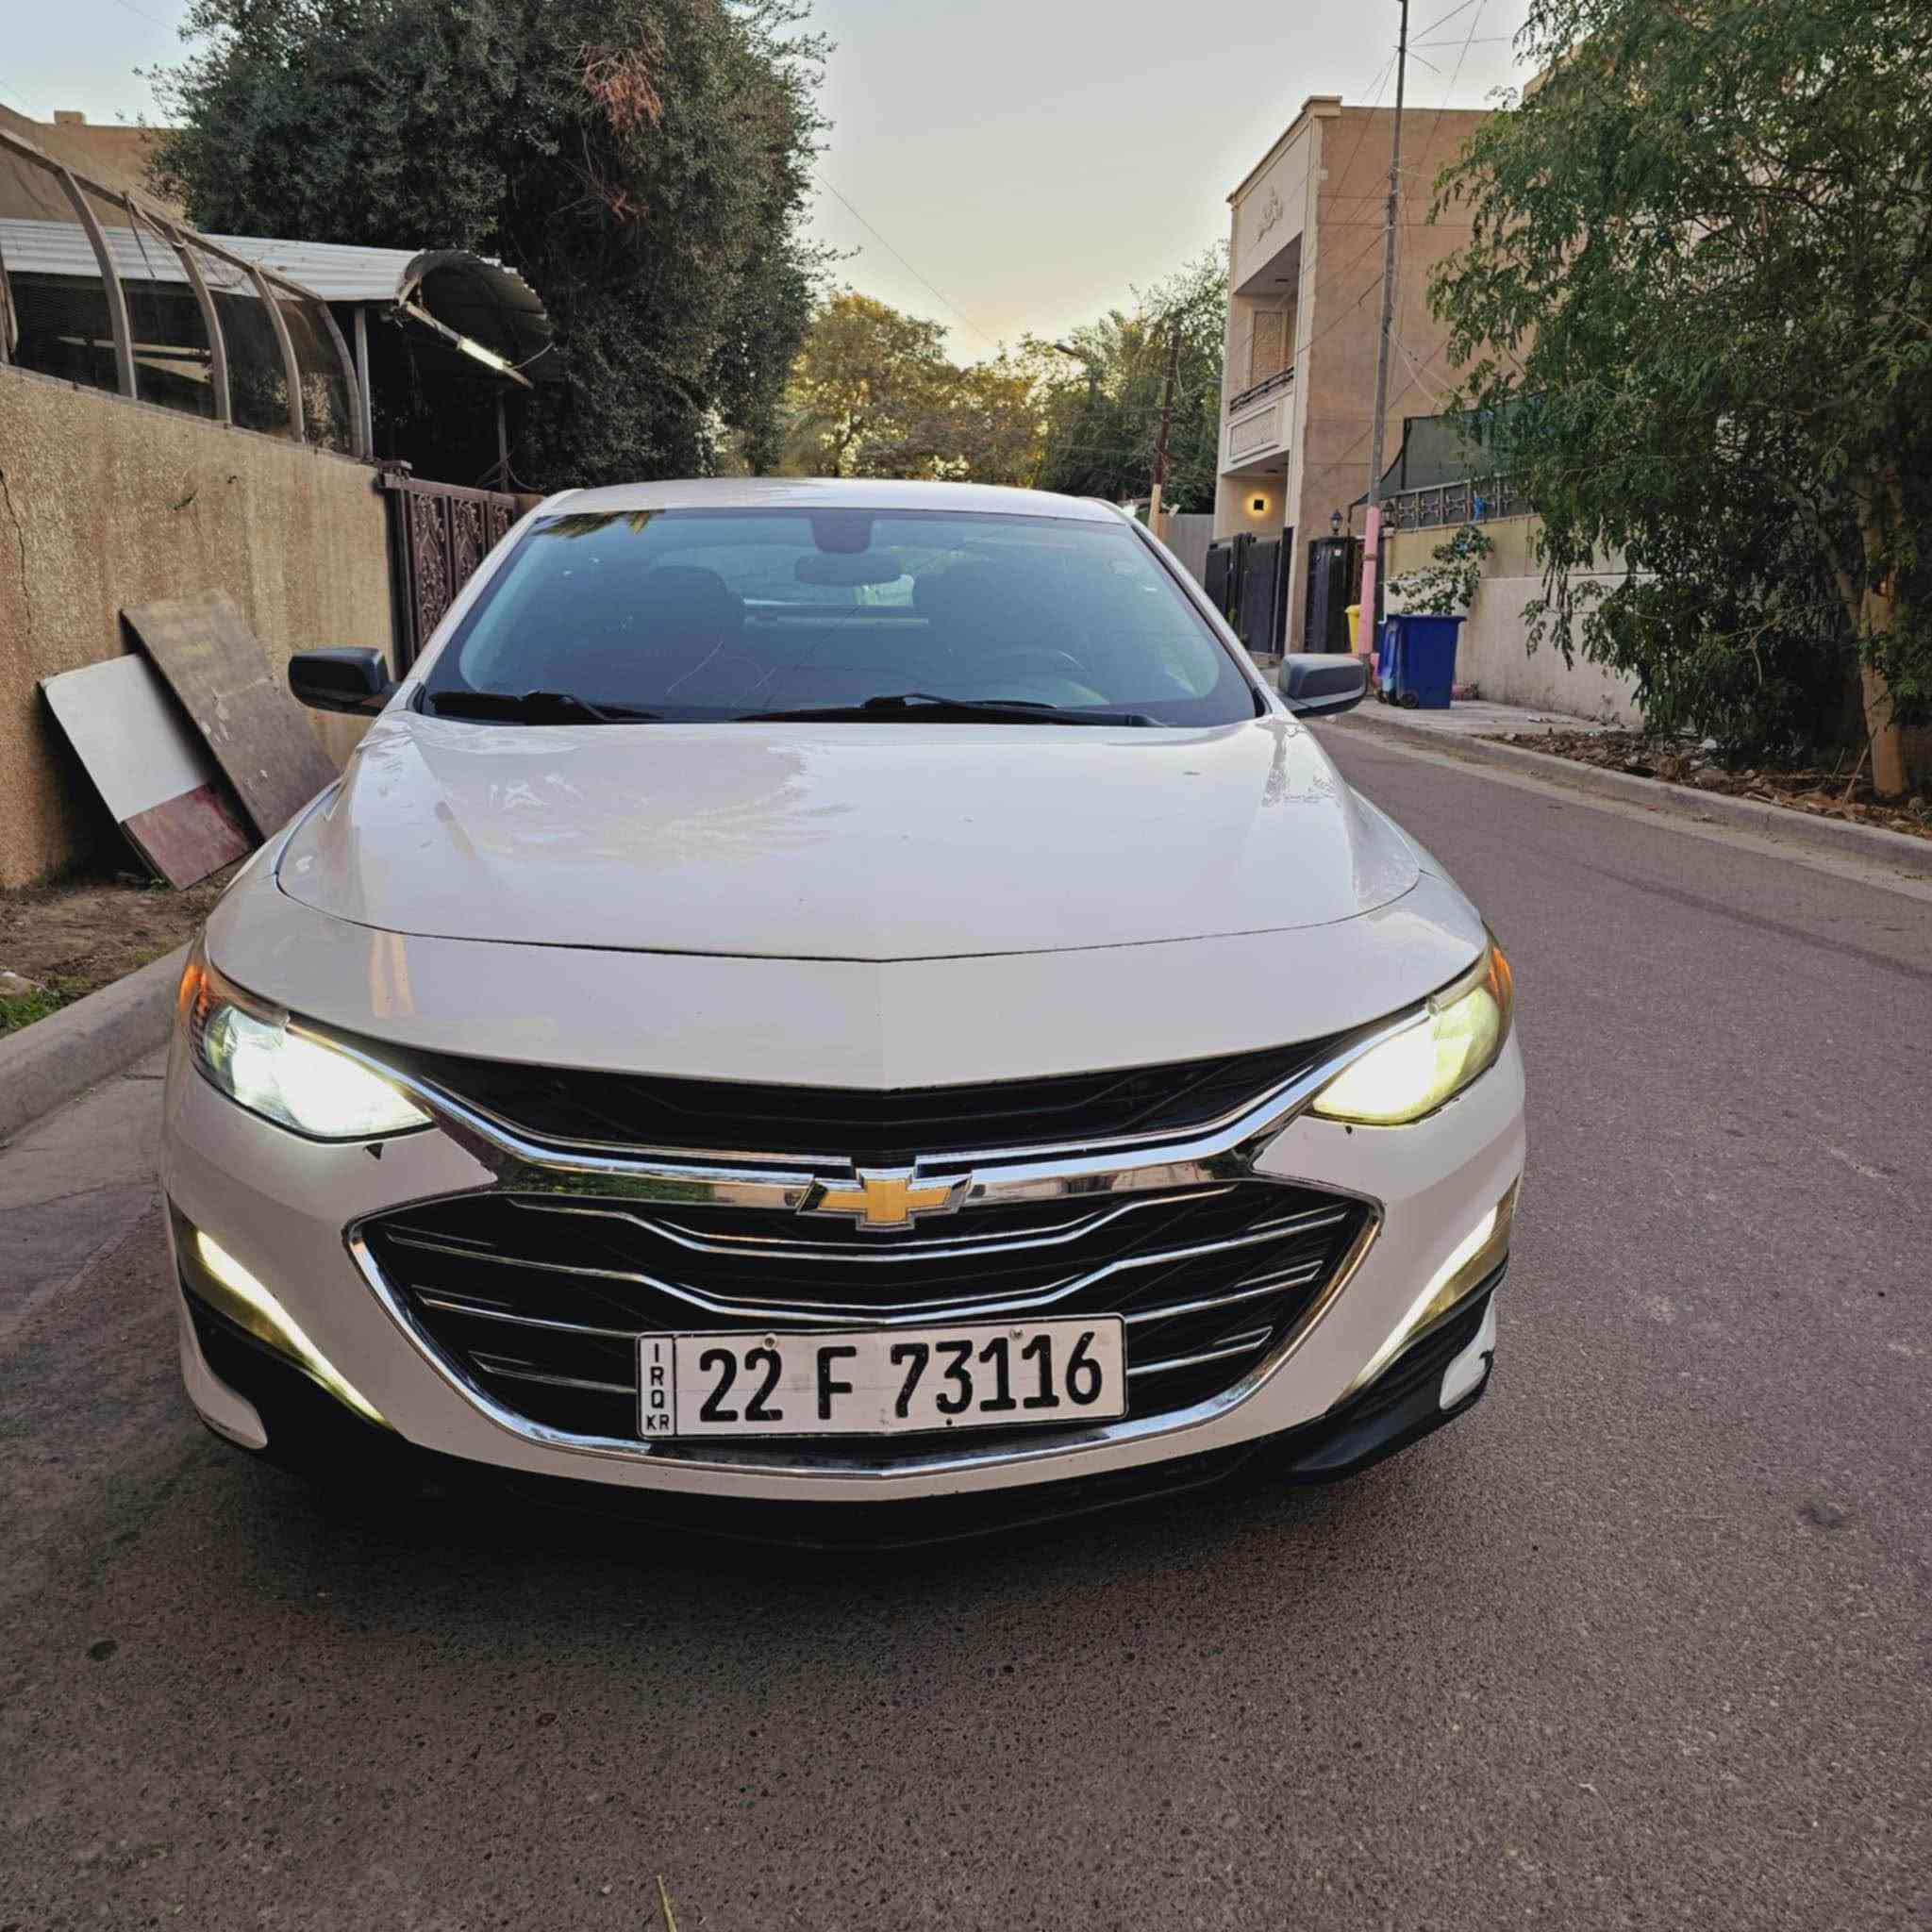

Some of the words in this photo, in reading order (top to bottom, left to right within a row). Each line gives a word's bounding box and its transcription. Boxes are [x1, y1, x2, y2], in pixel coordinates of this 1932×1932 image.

[650, 1342, 665, 1409] IRQ
[700, 1348, 783, 1423] 22
[816, 1345, 858, 1421] F
[890, 1331, 1103, 1419] 73116
[646, 1413, 670, 1431] KR
